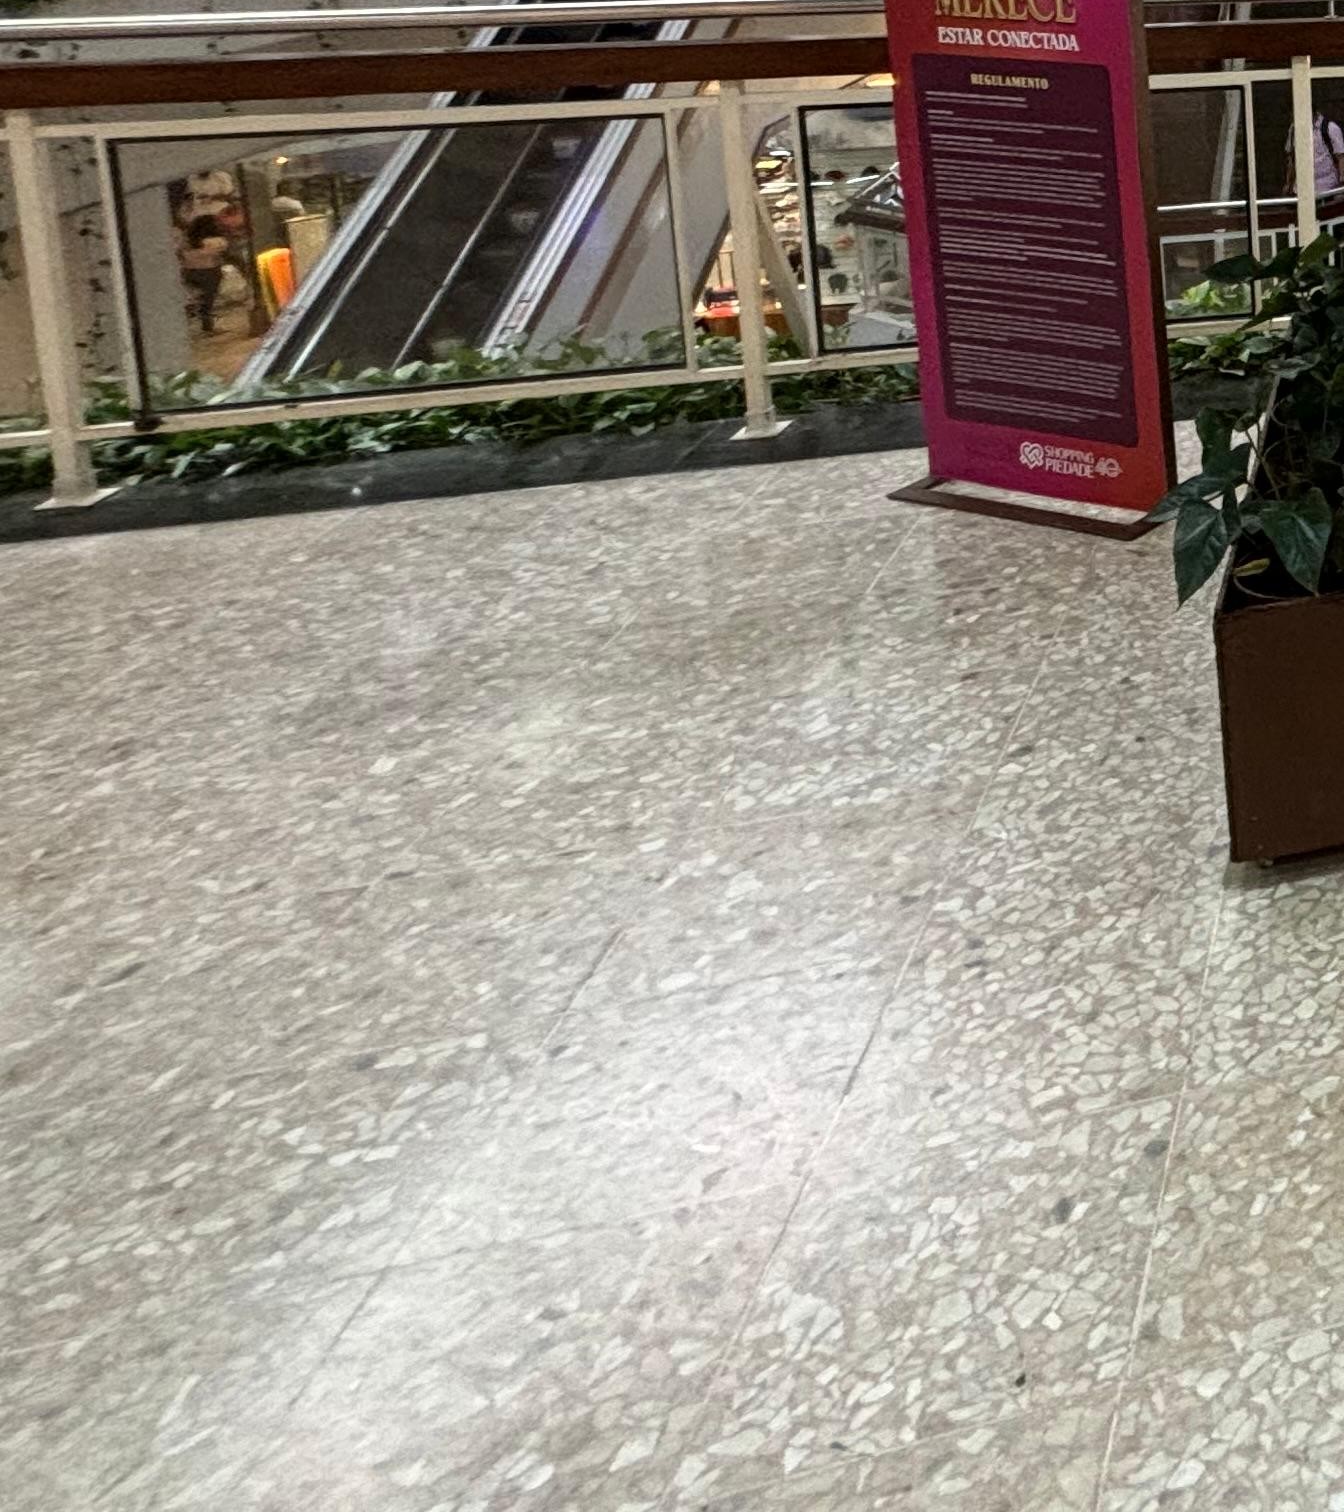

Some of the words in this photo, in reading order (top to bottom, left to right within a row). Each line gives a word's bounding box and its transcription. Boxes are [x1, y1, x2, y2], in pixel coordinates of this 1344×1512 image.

[937, 26, 985, 46] ESTAR
[986, 29, 1080, 51] CONECTADA
[969, 73, 1050, 90] REGULAMENTO
[1044, 457, 1096, 479] PIEDADE
